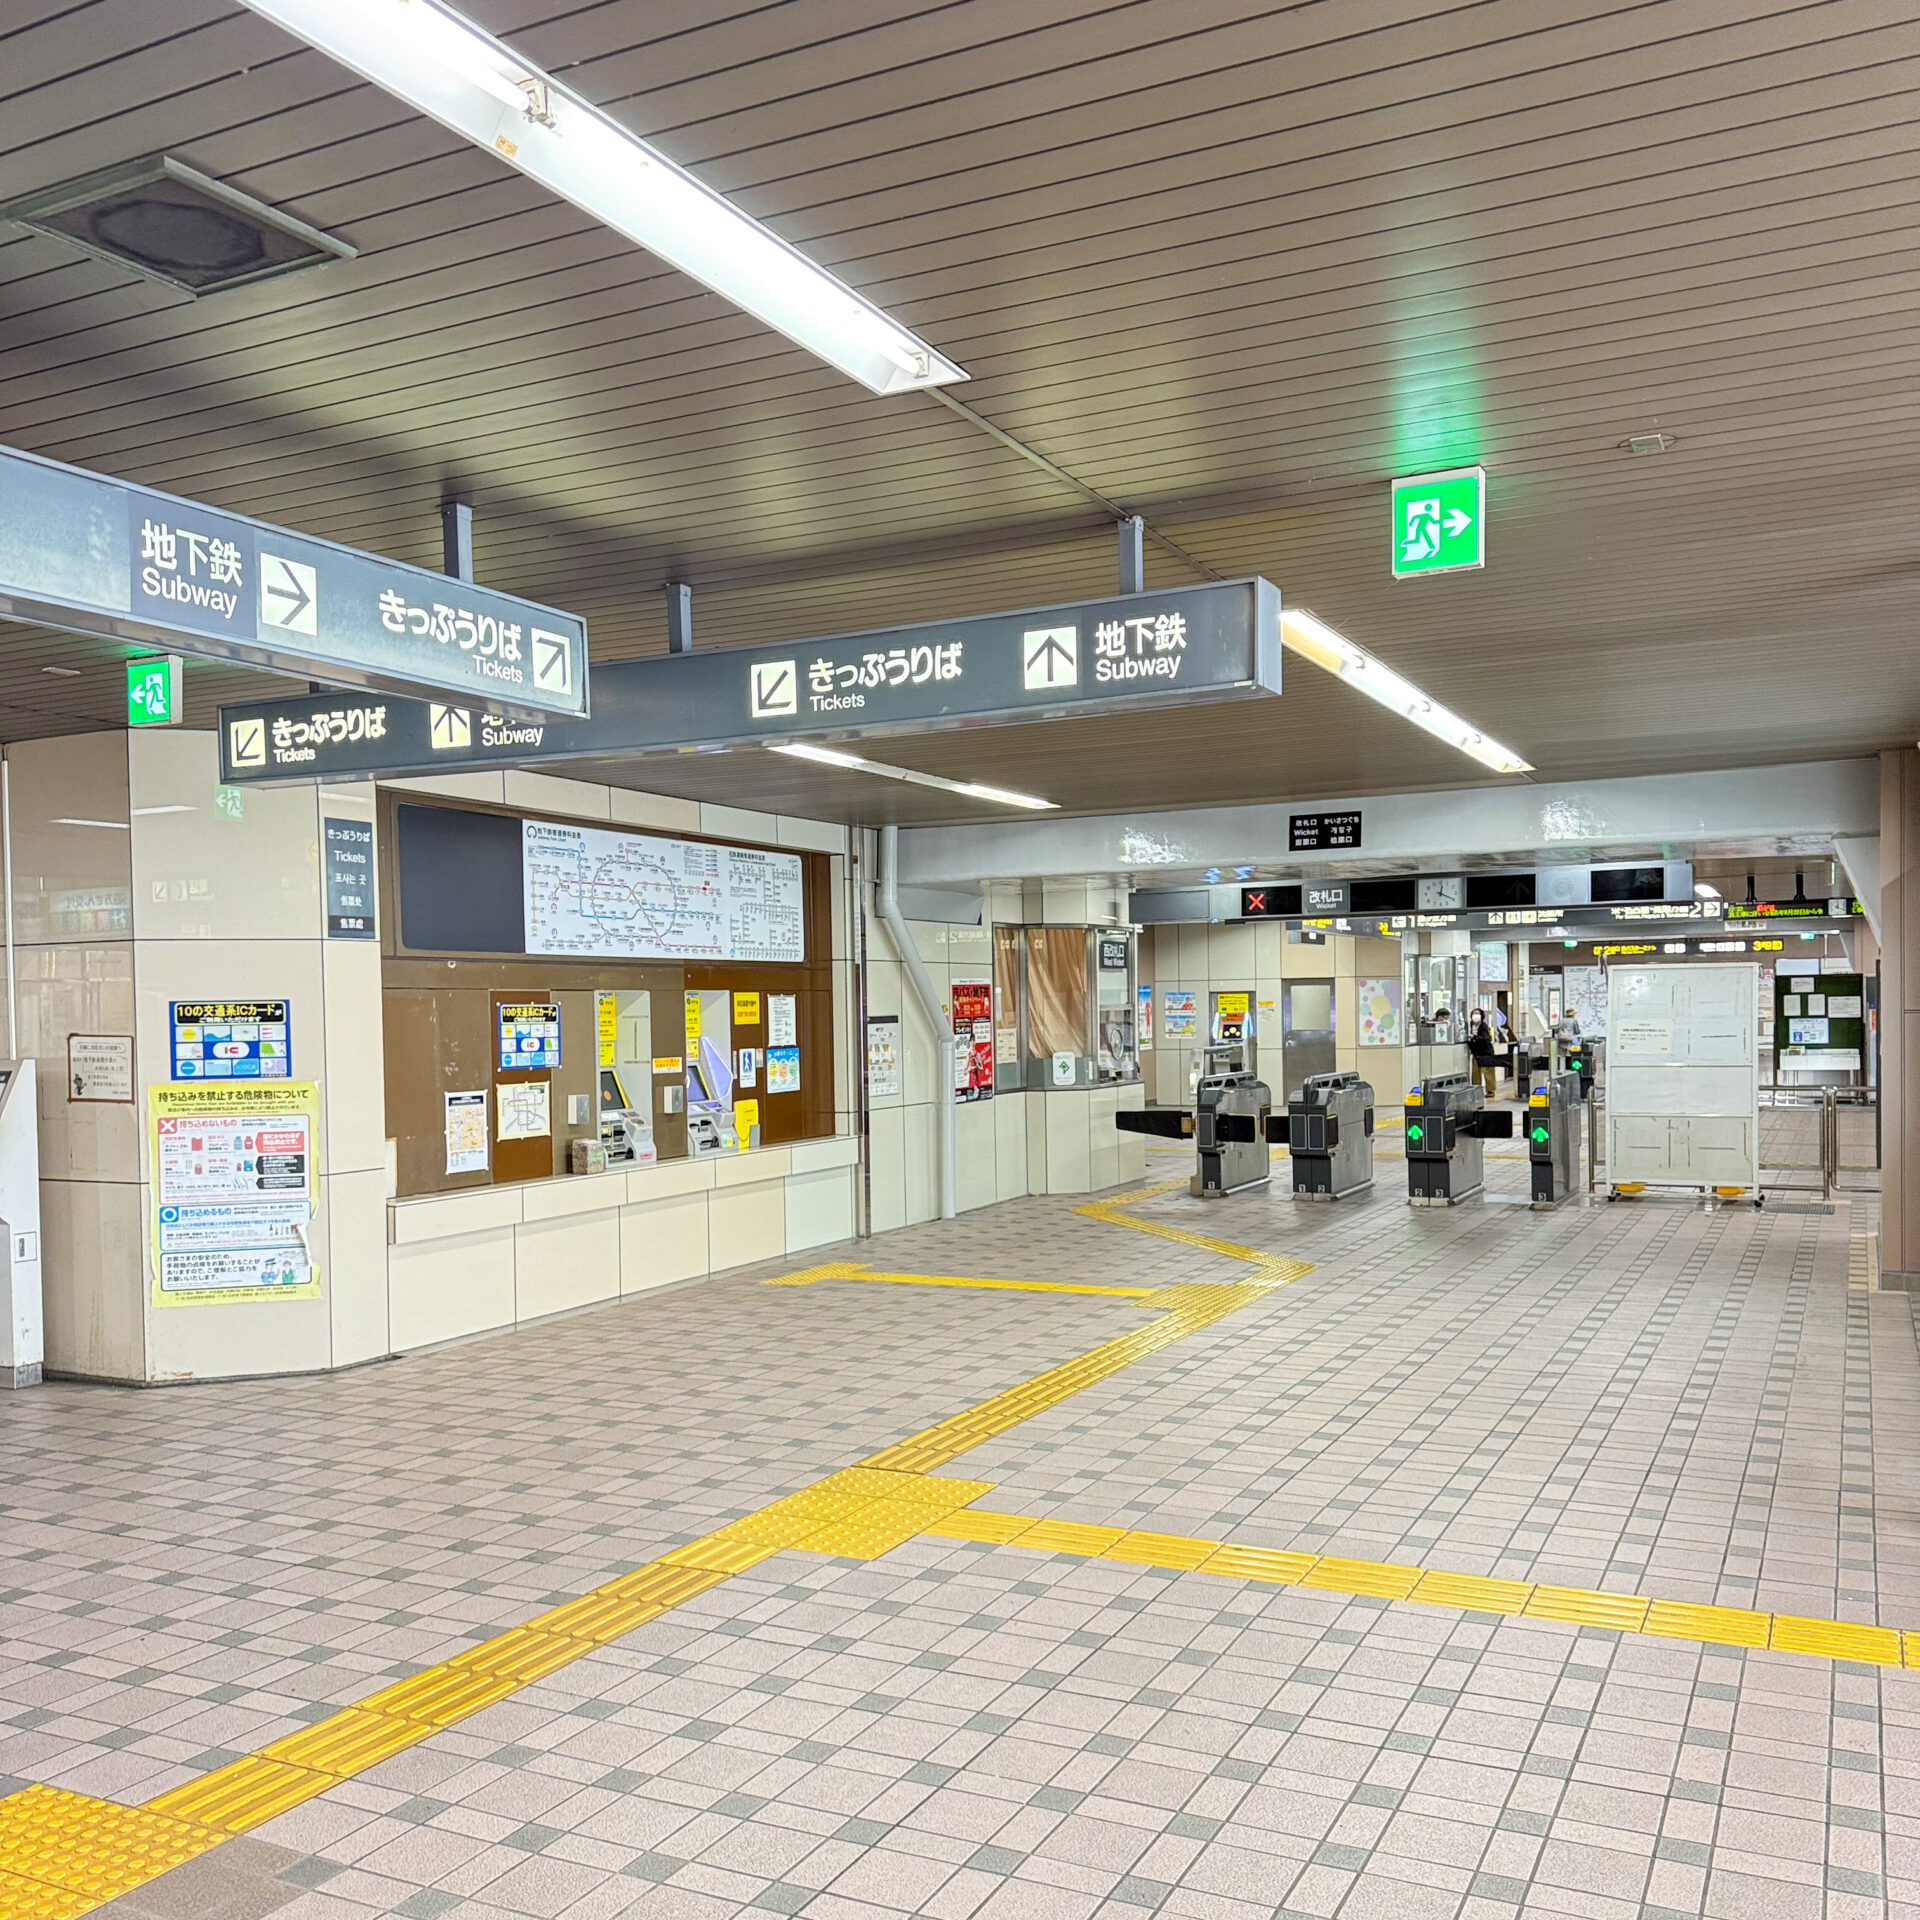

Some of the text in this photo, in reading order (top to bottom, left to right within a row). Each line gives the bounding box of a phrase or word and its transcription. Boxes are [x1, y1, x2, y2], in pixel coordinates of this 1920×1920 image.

[141, 518, 243, 588] 地下鉄
[141, 567, 238, 619] Subway
[378, 589, 522, 661] きっぷうりば
[1095, 612, 1187, 658] 地下鉄
[472, 656, 523, 684] Tickets
[808, 641, 963, 694] きっぷうりば
[1096, 654, 1182, 682] Subway
[809, 693, 865, 712] Tickets
[272, 705, 386, 743] きっぷうりば
[482, 727, 544, 747] Subway
[273, 746, 316, 764] Tickets
[1294, 828, 1319, 836] Wicket
[1295, 818, 1317, 827] 改札口
[333, 850, 366, 864] Tickets
[1308, 889, 1343, 904] 改札口
[1316, 902, 1337, 910] Wicket
[158, 1089, 309, 1103] 持ち込みを禁止する危険物について
[179, 1119, 237, 1128] 持ち込めないもの
[181, 1207, 232, 1218] 持ち込めるもの
